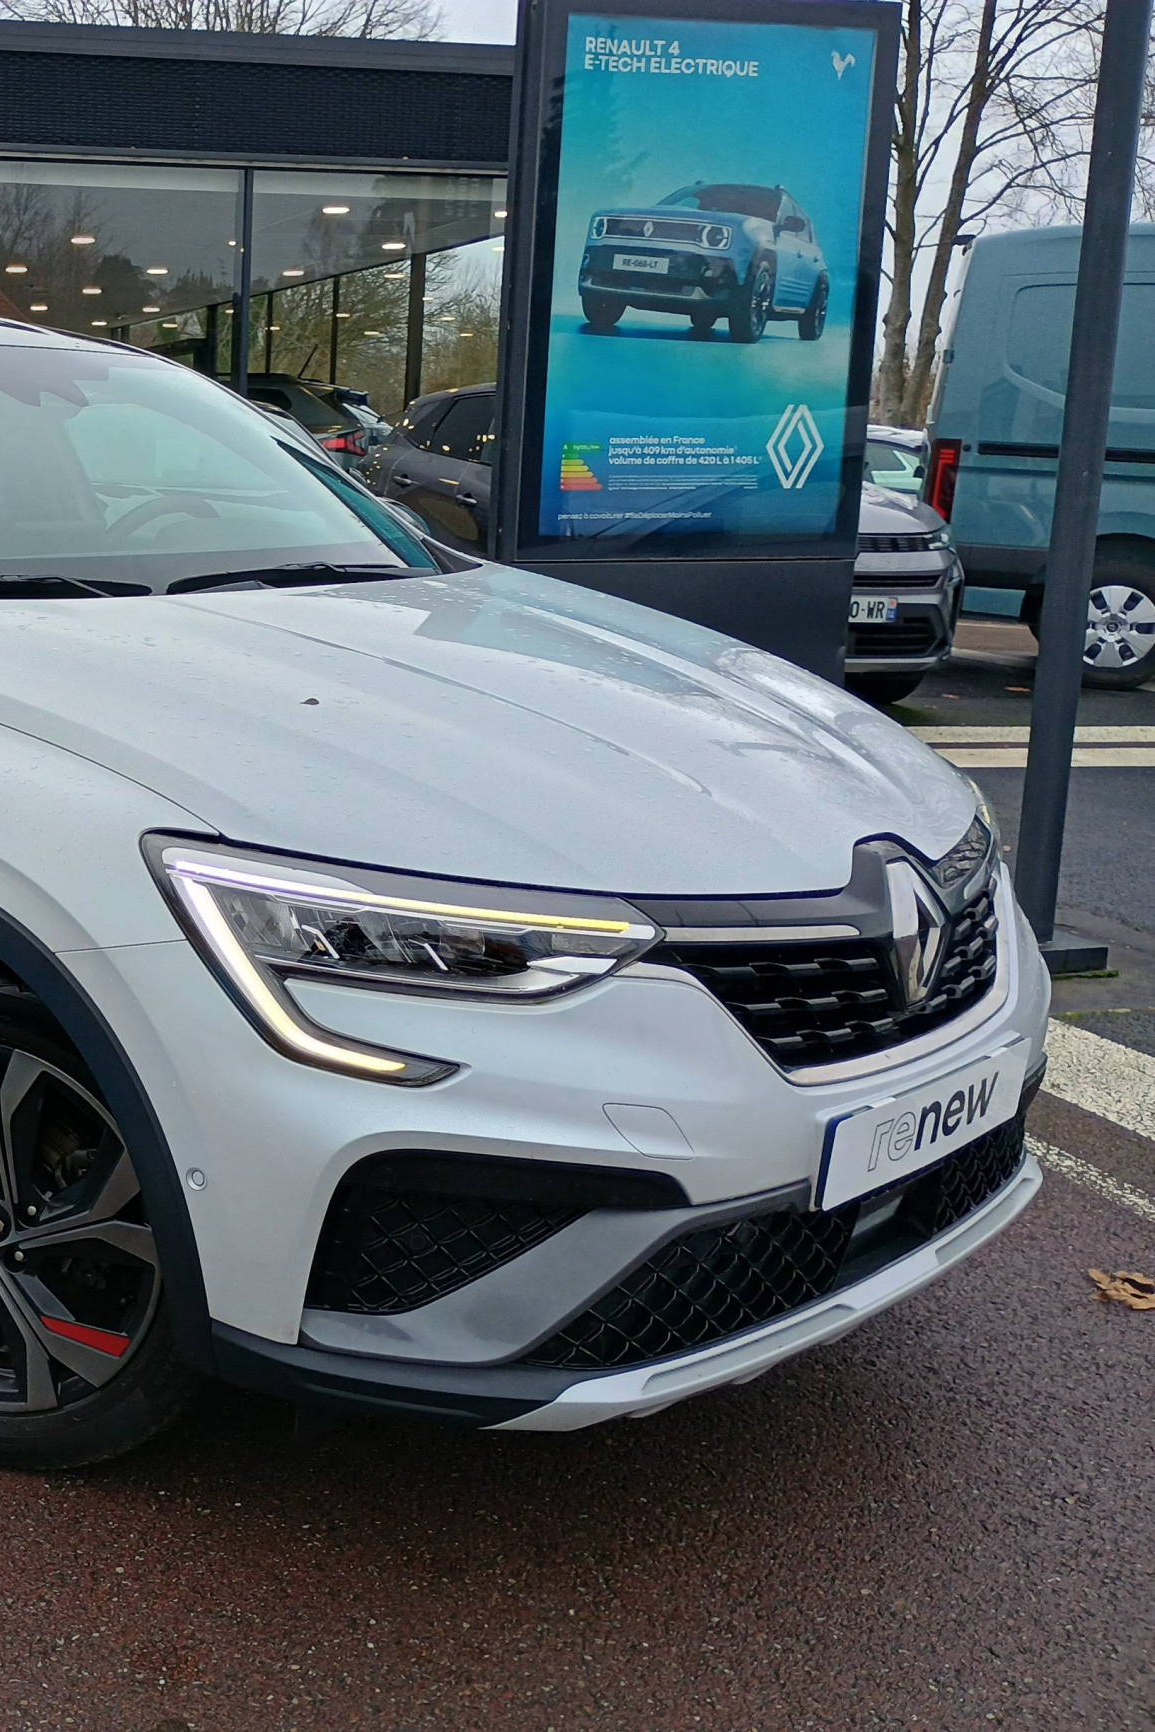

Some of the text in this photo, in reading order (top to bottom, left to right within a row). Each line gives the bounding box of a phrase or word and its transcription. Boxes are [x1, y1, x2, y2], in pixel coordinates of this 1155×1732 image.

[586, 36, 681, 56] RENAULT 4
[584, 54, 760, 78] E-TECH ELECTRIQUE
[660, 437, 673, 445] en
[673, 435, 706, 445] France
[608, 446, 642, 457] jusqu'à
[642, 446, 661, 455] 409
[661, 446, 676, 455] km
[608, 455, 643, 465] volume
[643, 455, 656, 465] de
[656, 455, 685, 465] coffre
[685, 455, 698, 465] de
[698, 456, 716, 465] 420
[867, 1070, 1000, 1173] renew
